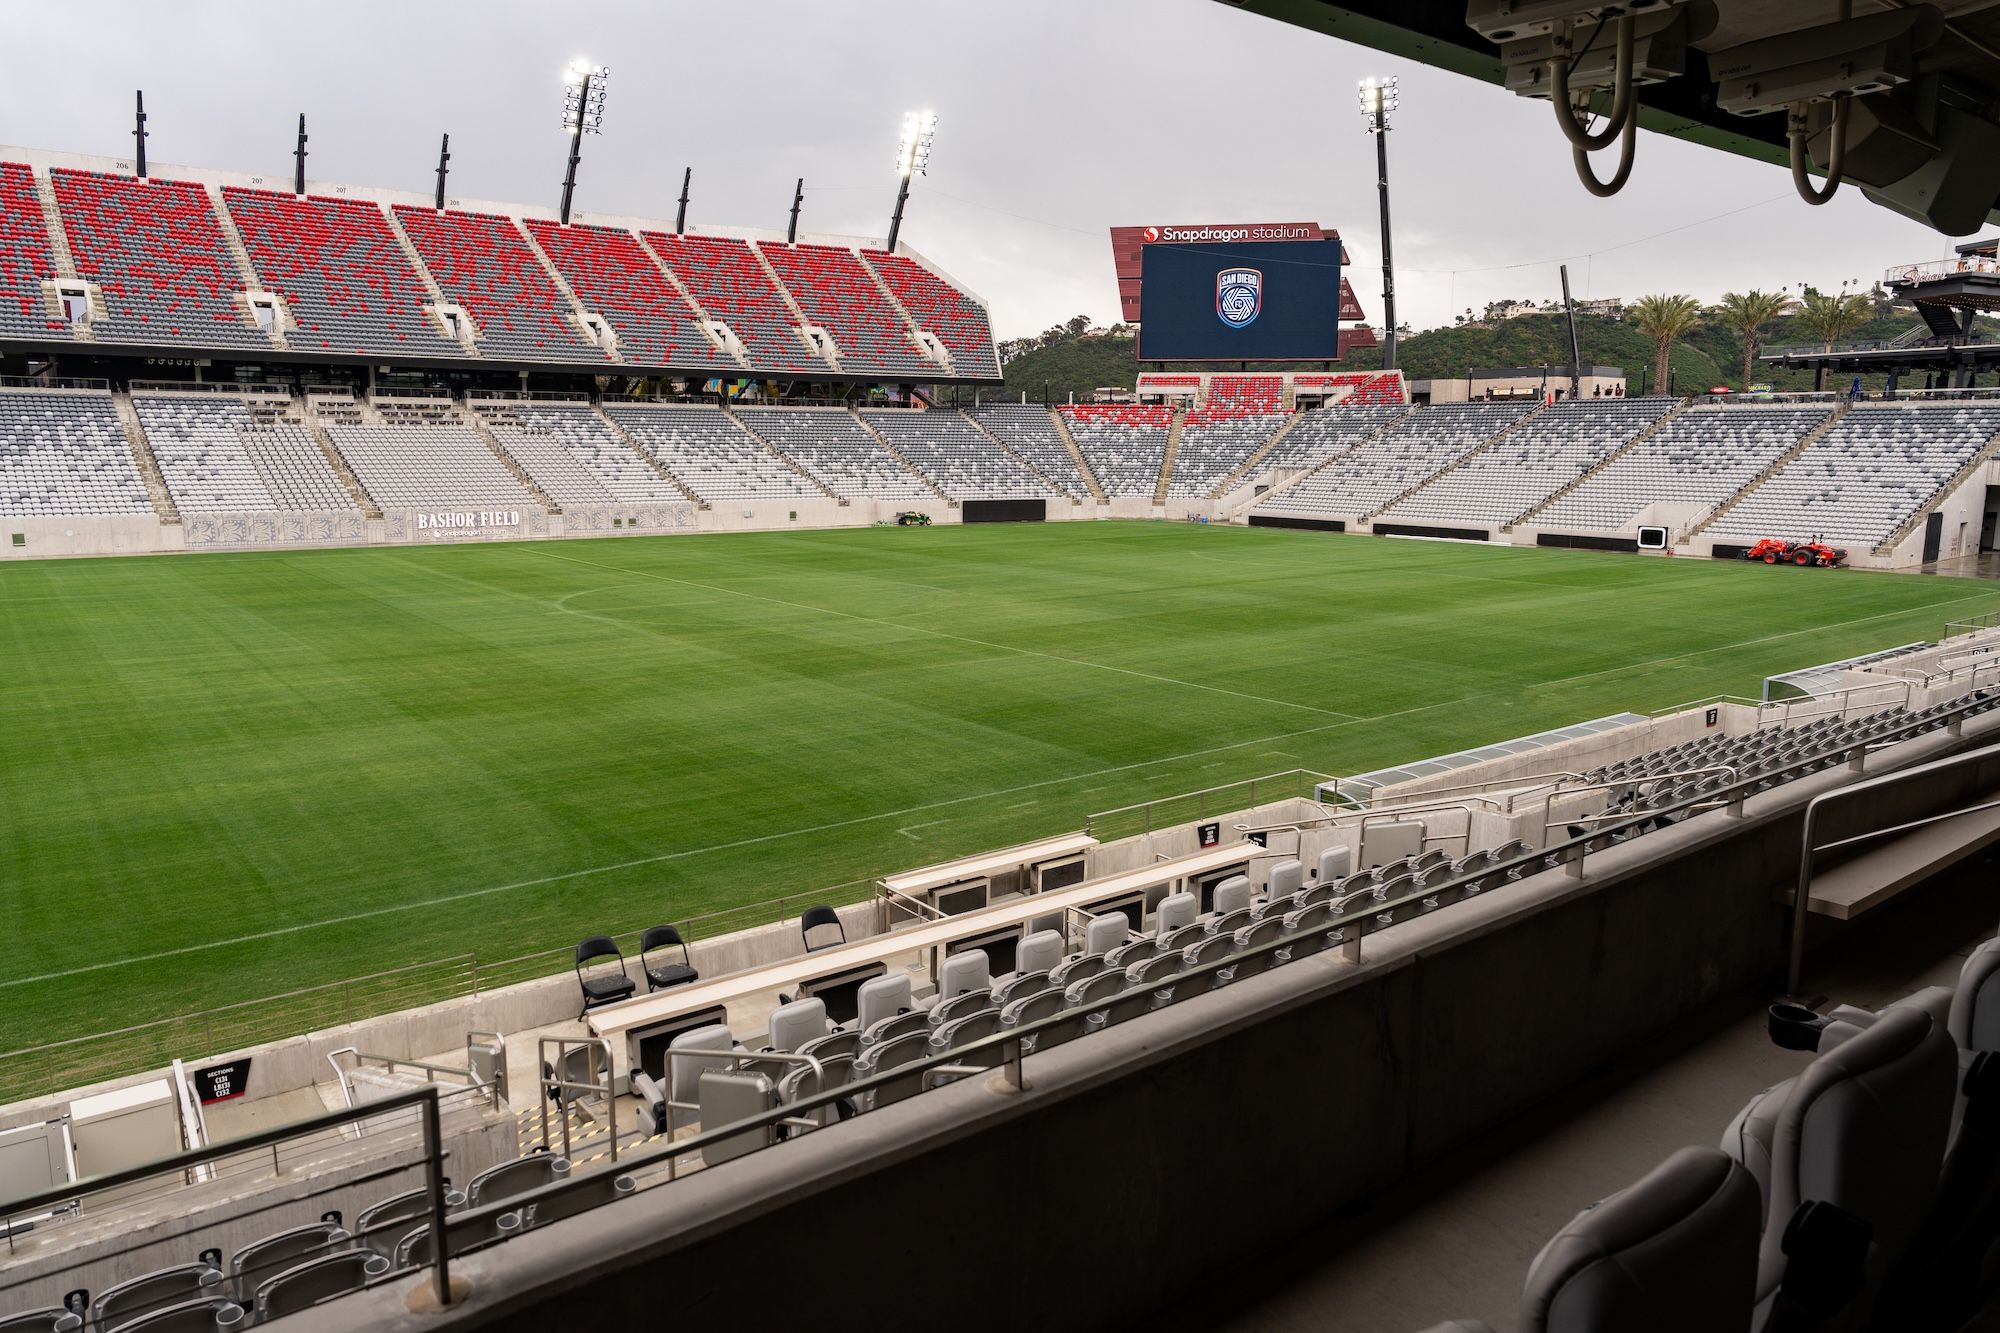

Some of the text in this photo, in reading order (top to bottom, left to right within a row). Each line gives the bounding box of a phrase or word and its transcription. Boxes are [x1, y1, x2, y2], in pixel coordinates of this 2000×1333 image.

[115, 162, 129, 170] 206
[251, 177, 263, 185] 207
[1163, 225, 1310, 242] Snapdragon stadium
[1221, 273, 1257, 286] SAN DIEGO
[1234, 300, 1243, 308] FC
[418, 511, 520, 529] BASHOR FIELD
[442, 529, 480, 538] Snapdragon
[207, 1067, 234, 1078] SECTIONS
